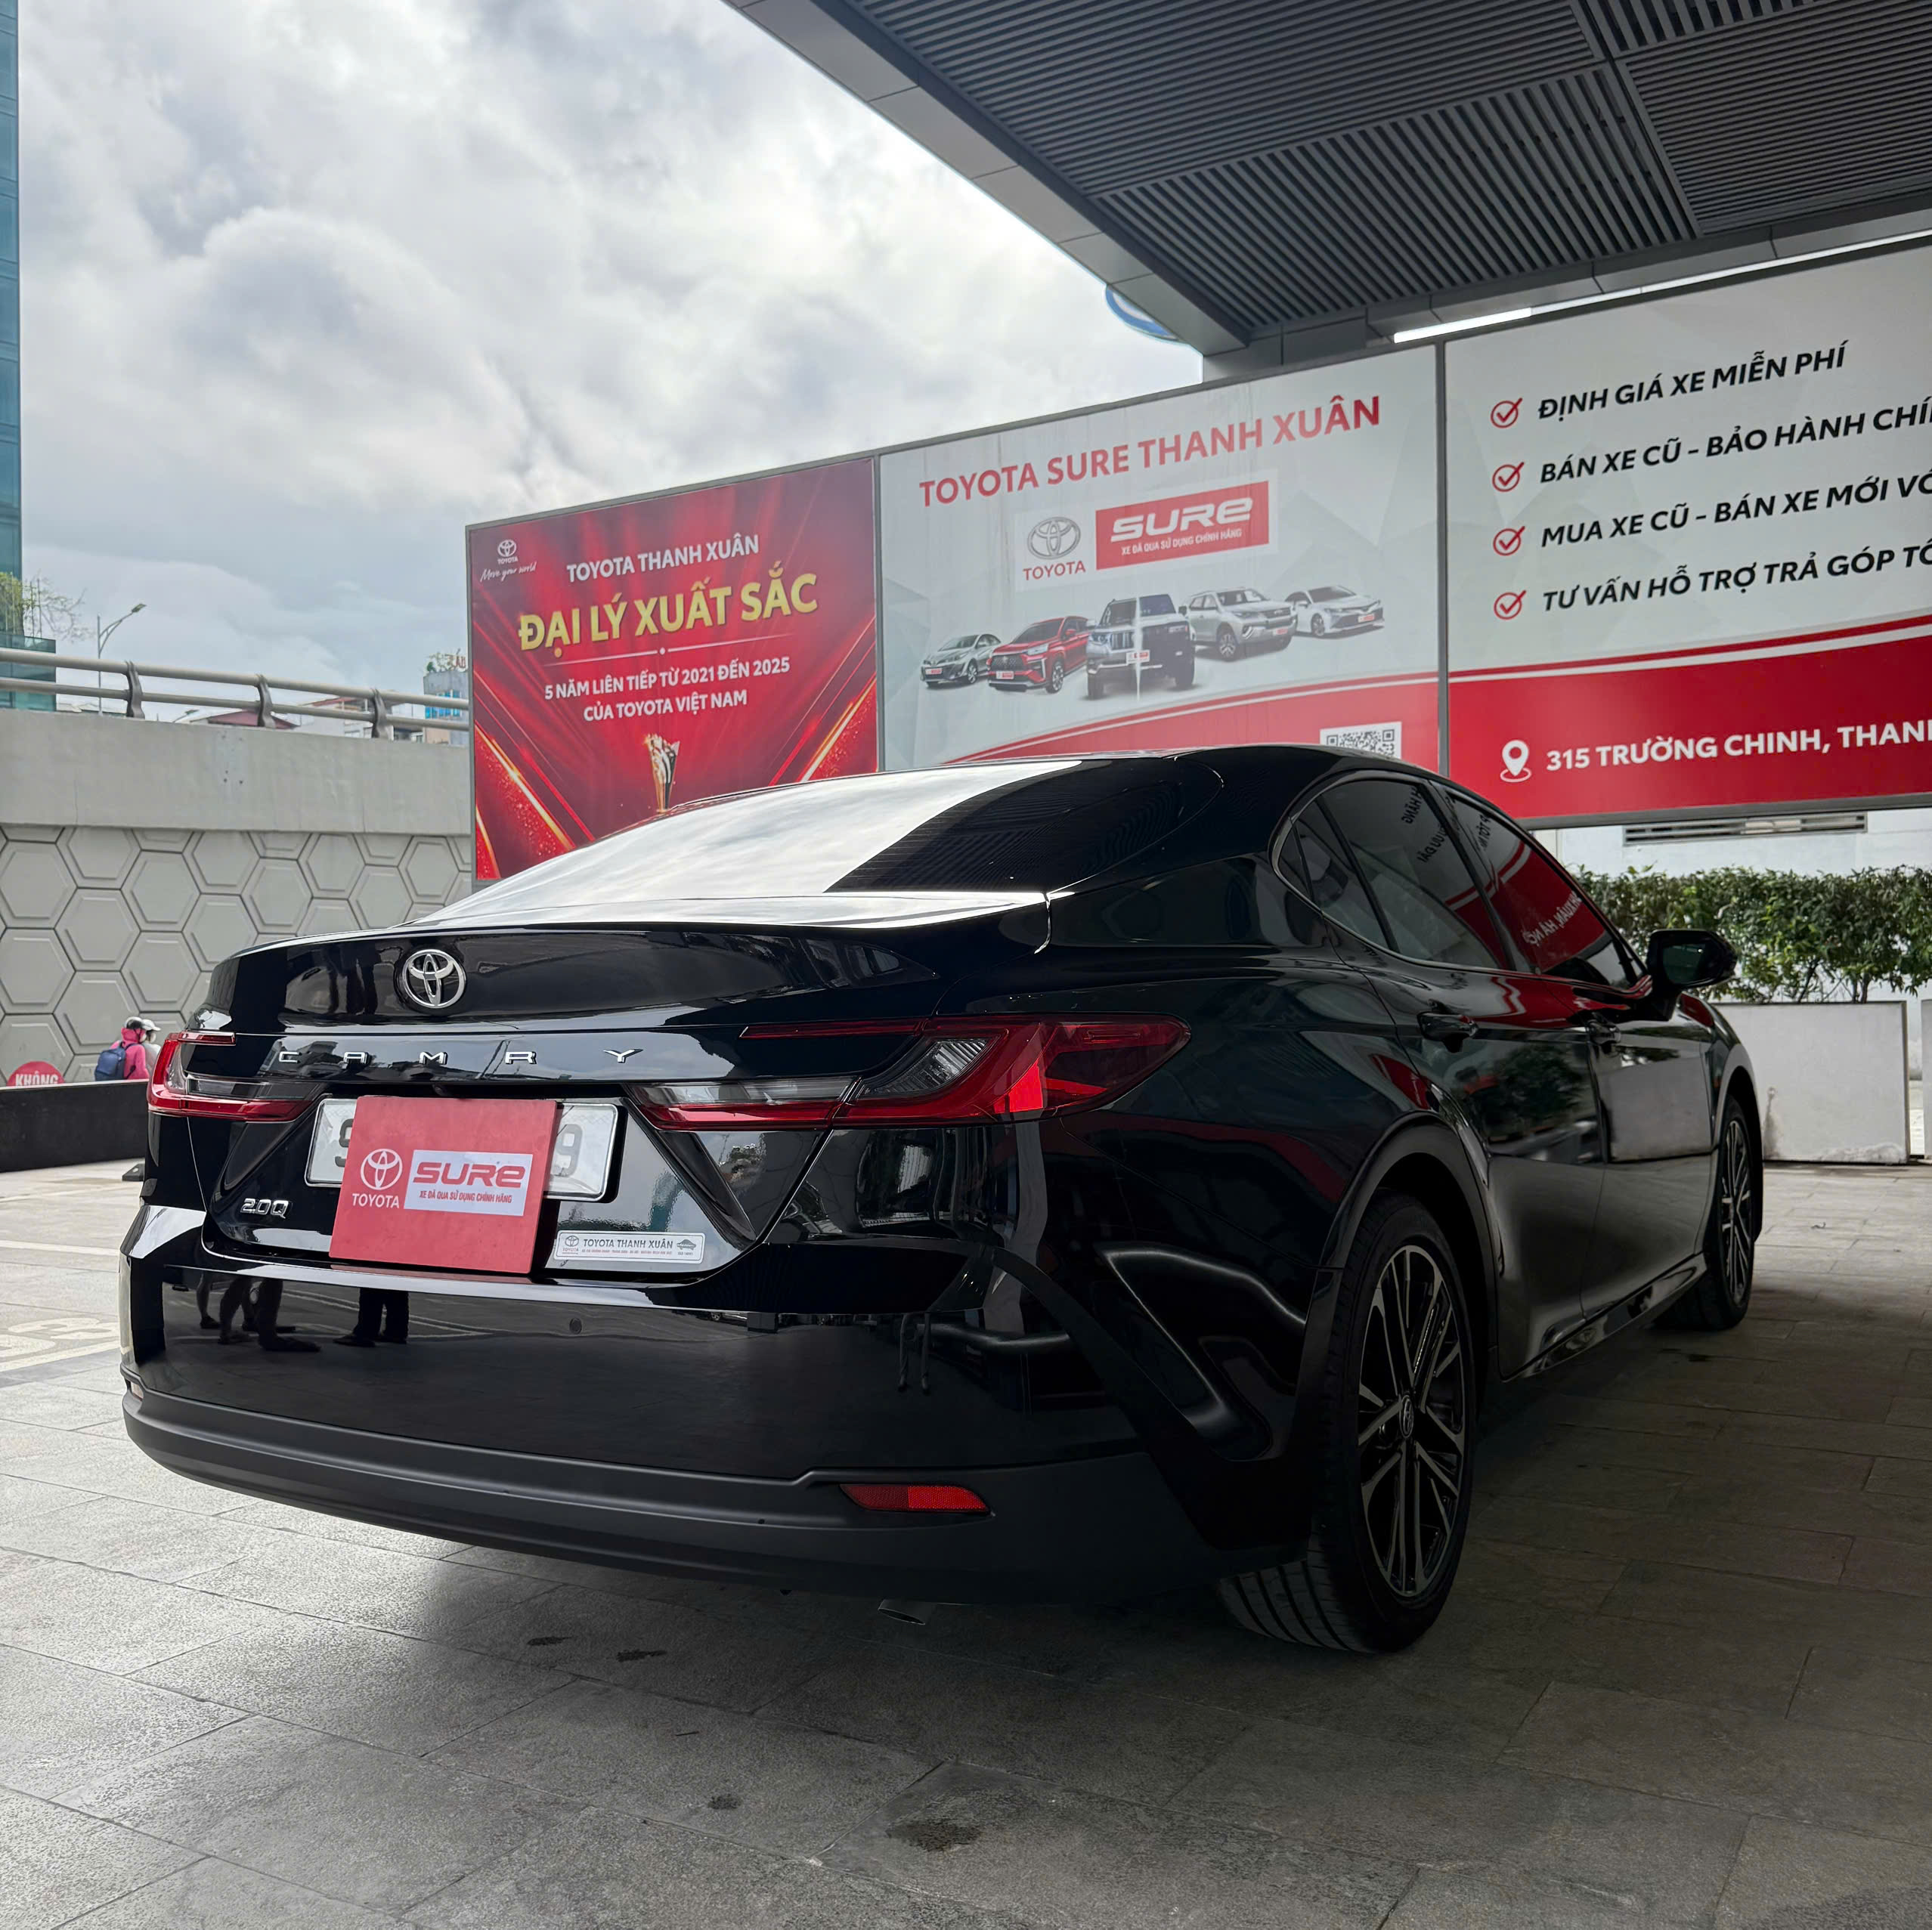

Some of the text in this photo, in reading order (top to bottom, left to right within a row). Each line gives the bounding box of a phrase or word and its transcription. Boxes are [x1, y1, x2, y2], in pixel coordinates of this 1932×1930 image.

[1538, 340, 1850, 422] ĐỊNH GIÁ XE MIỄN PHÍ
[919, 394, 1381, 507] TOYOTA SURE THANH XUÂN
[1540, 453, 1596, 483] BÁN
[1602, 450, 1635, 474] XE
[1643, 438, 1682, 466] CŨ
[1706, 426, 1767, 457] BẢO
[1774, 413, 1865, 446] HÀNH
[1873, 396, 1932, 431] CHÍ
[1110, 497, 1252, 543] SURE
[1541, 523, 1602, 547] MUA
[1609, 514, 1643, 538] XE
[1650, 503, 1689, 530] CŨ
[1714, 493, 1775, 522] BÁN
[1782, 489, 1819, 513] XE
[1826, 475, 1888, 507] MỚI
[567, 532, 759, 583] TOYOTA THANH XUÂN
[1023, 561, 1086, 580] TOYOTA
[1121, 546, 1132, 555] XE
[1144, 542, 1160, 552] QUA
[1543, 585, 1580, 611] TƯ
[1584, 576, 1640, 607] VẤN
[1647, 564, 1691, 598] HỖ
[1698, 562, 1757, 593] TRỢ
[1763, 552, 1819, 583] TRẢ
[1826, 543, 1895, 576] GÓP
[519, 561, 818, 657] ĐẠI LÝ XUẤT SẮC
[544, 656, 790, 701] 5 NĂM LIÊN TIẾP TỪ 2021 ĐẾN 2025
[584, 688, 748, 722] CỦA TOYOTA VIỆT NAM
[1546, 719, 1932, 771] 315 TRƯỜNG CHINH, THAN
[279, 1048, 643, 1065] CAMRY
[413, 1162, 526, 1188] SURE
[437, 1191, 448, 1200] QUA
[352, 1193, 400, 1209] TOYOTA
[584, 1238, 673, 1248] TOYOTA THANH XUÂN
